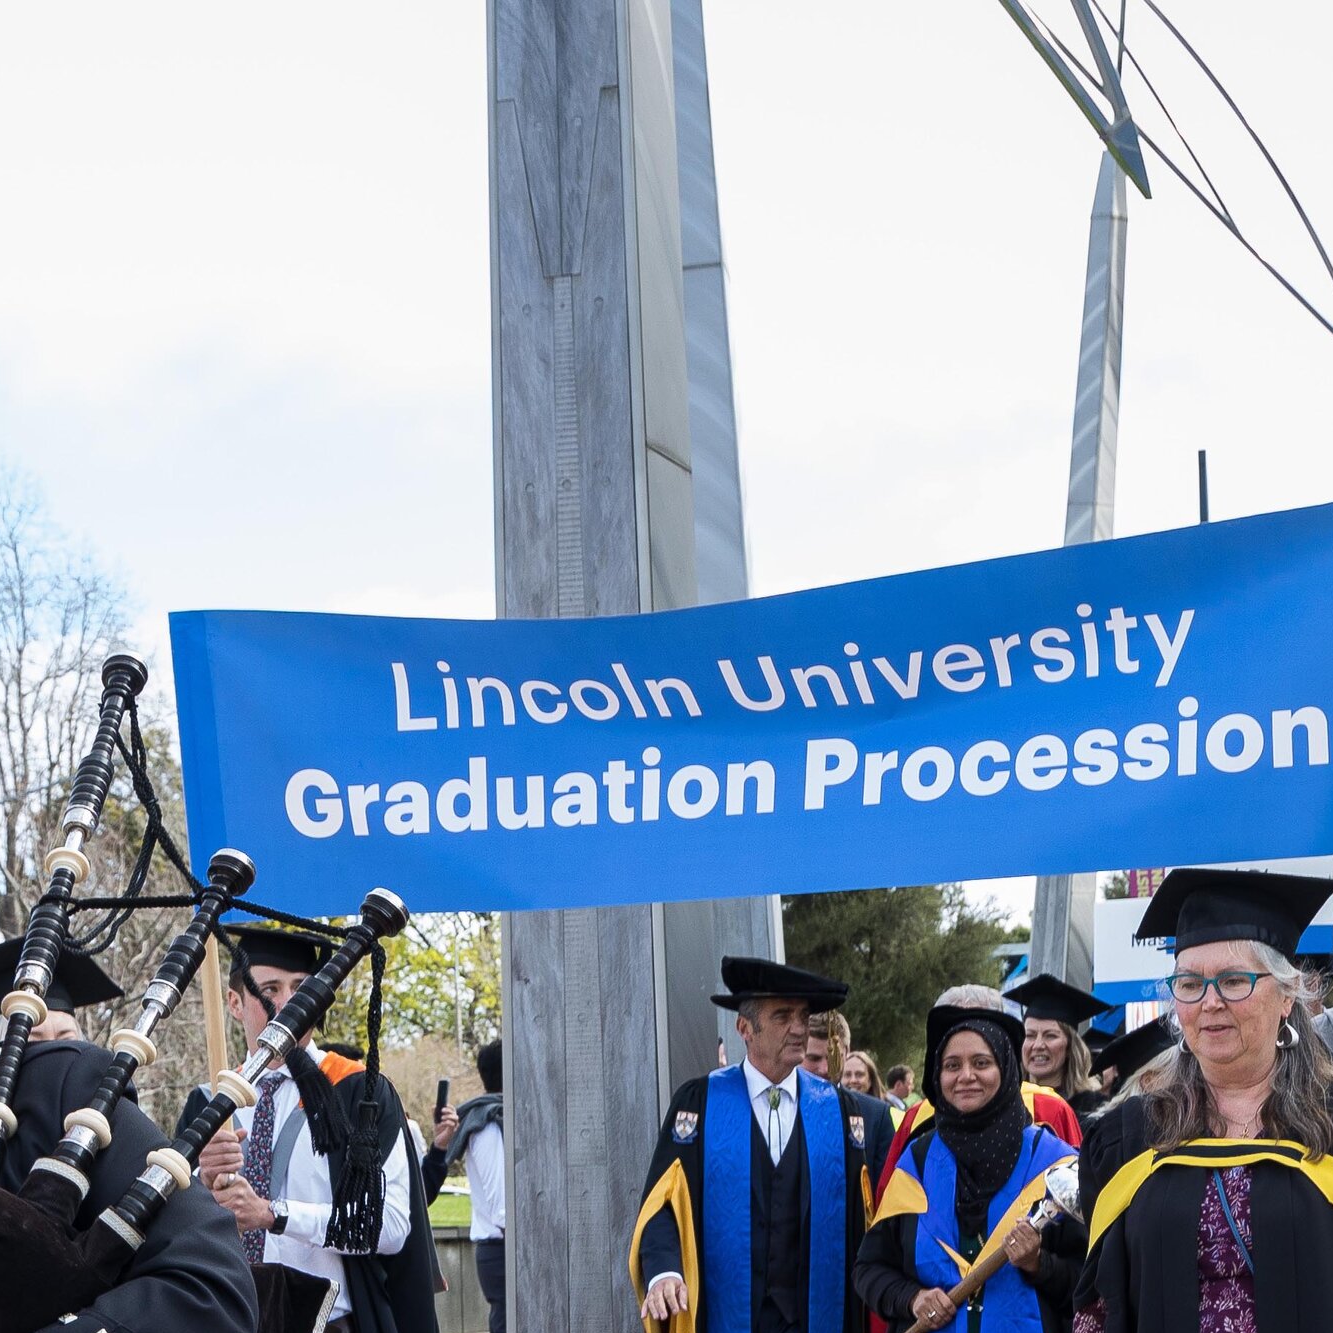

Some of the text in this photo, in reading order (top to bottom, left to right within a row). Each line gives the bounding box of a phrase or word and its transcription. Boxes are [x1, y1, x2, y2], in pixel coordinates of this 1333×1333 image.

[391, 603, 1195, 731] Lincoln University
[285, 697, 1330, 839] Graduation Procession
